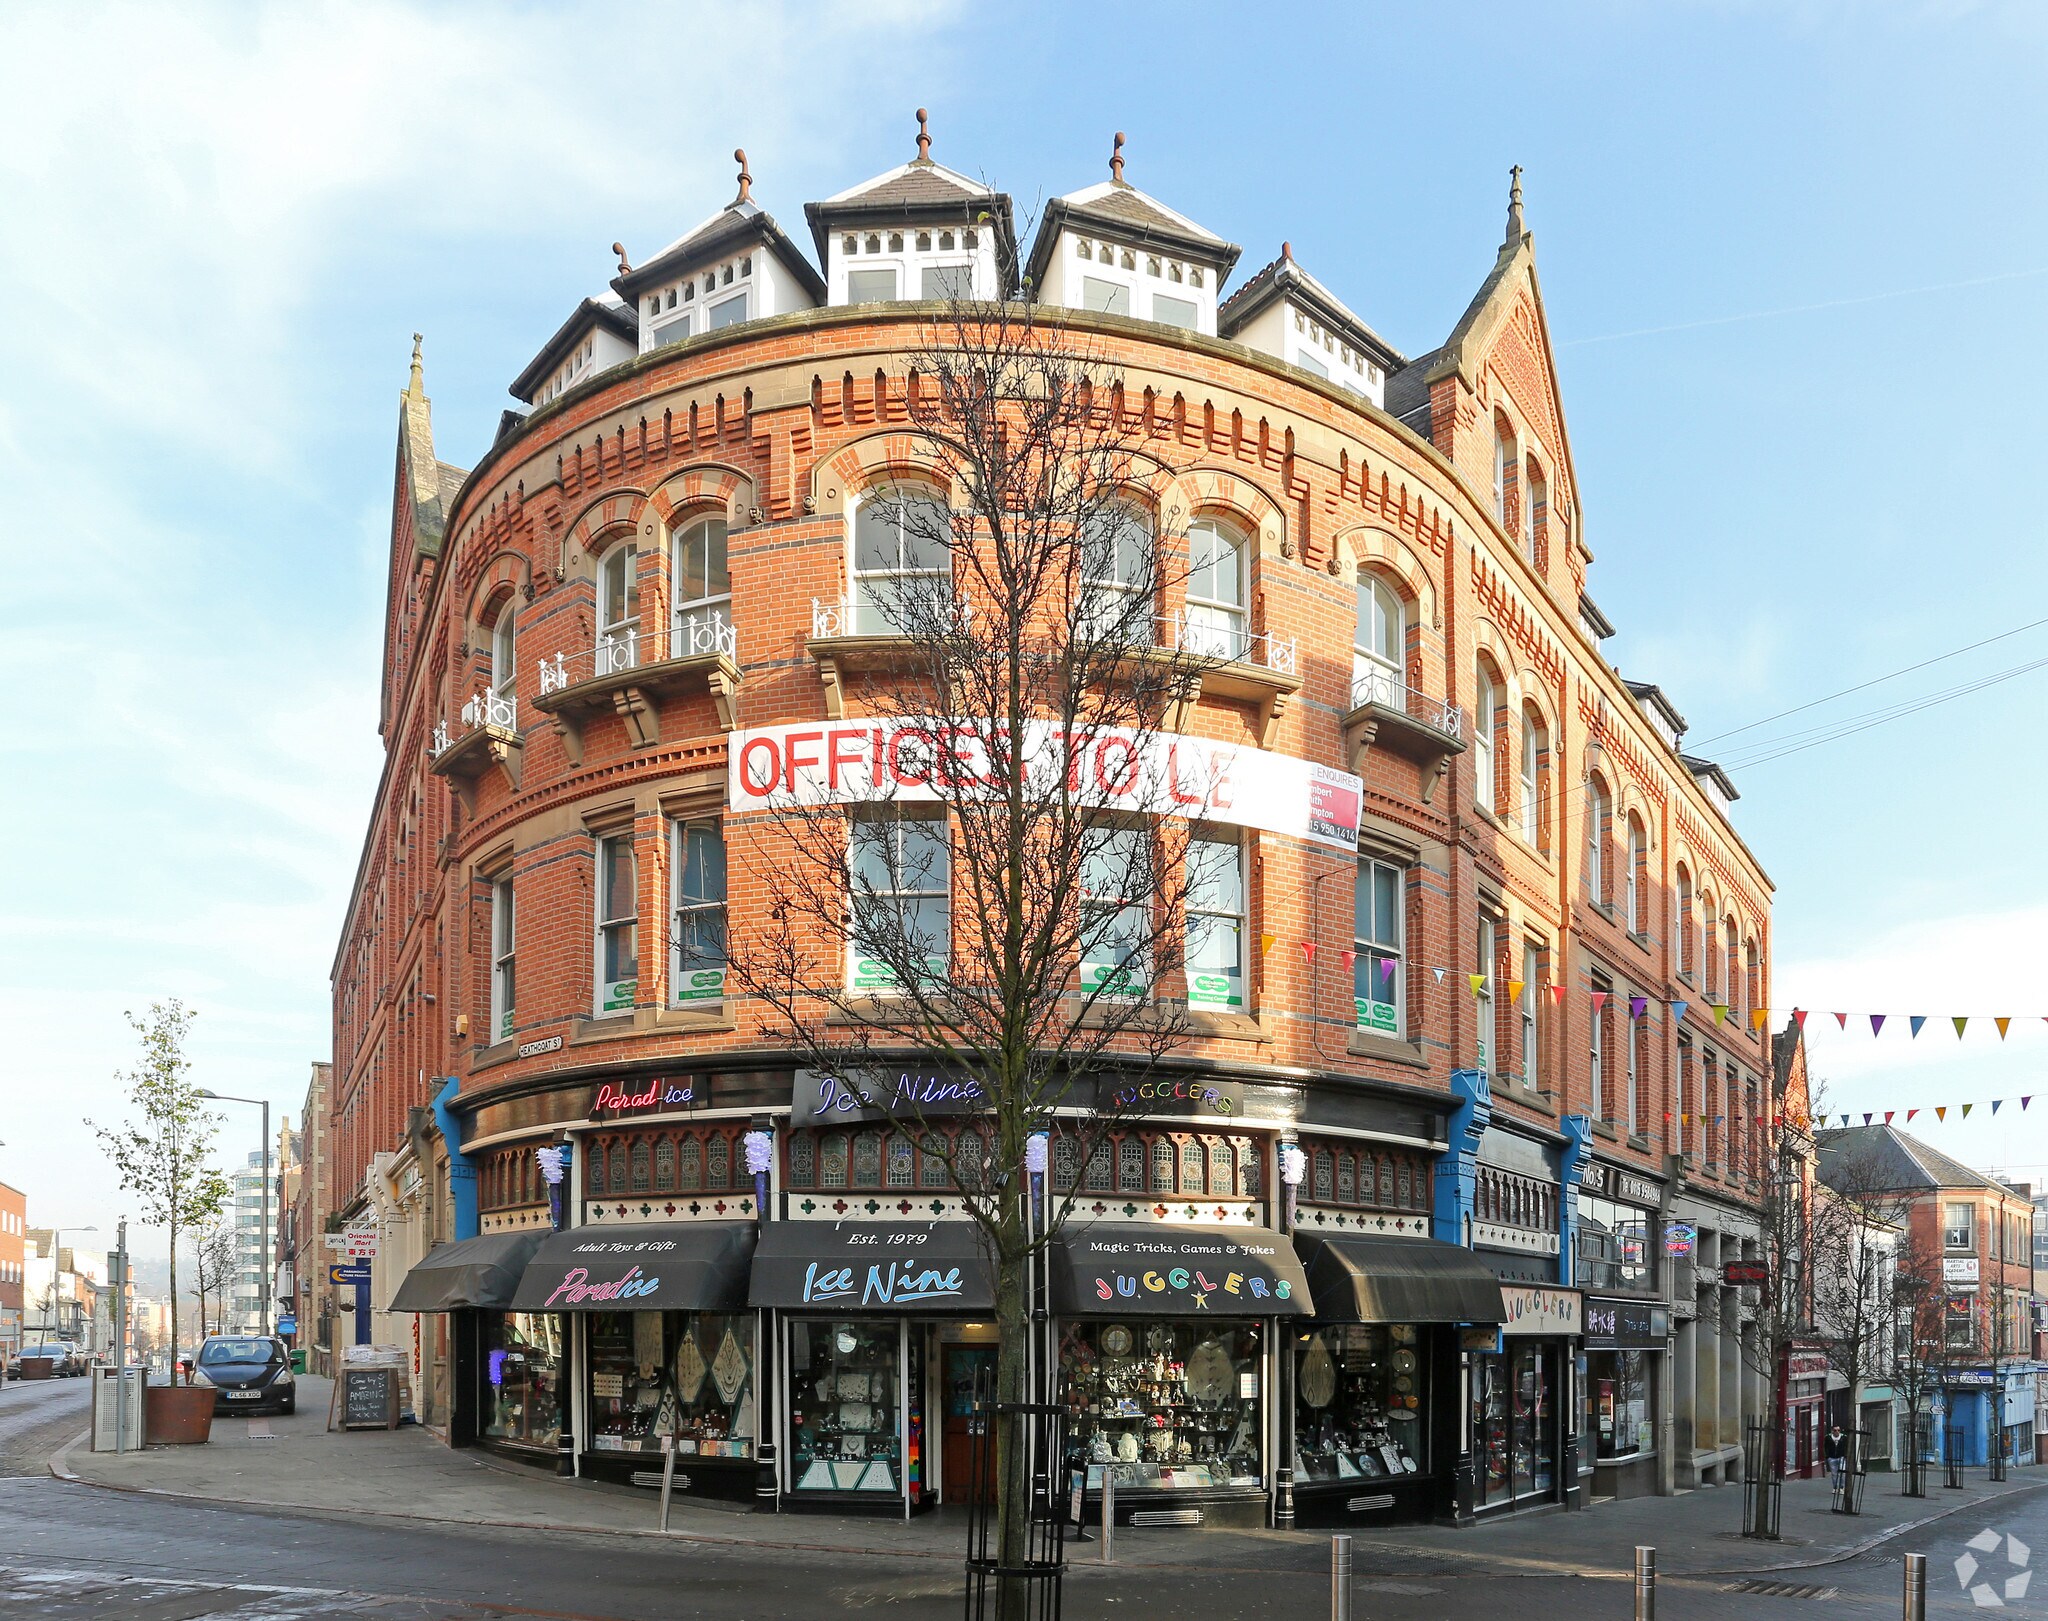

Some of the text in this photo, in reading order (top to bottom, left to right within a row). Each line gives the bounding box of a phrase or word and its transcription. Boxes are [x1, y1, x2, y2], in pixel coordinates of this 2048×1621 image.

[1052, 731, 1139, 796] TO
[1168, 743, 1239, 808] LE
[1316, 767, 1359, 789] ENQUIRES
[1311, 785, 1332, 798] mbert
[1310, 806, 1334, 820] mpton
[1320, 823, 1335, 835] 950
[1336, 827, 1355, 841] 1414
[520, 1040, 551, 1056] HEATHCOAT
[813, 1073, 983, 1116] Ice Nine
[347, 1232, 376, 1240] Oriental
[847, 1233, 928, 1245] Est. 1979
[572, 1239, 677, 1253] Adult Toys & Gifts
[1090, 1241, 1275, 1257] Magic Tricks, Games & Jokes
[1668, 1243, 1689, 1251] OPEN
[544, 1265, 660, 1307] Paradice
[802, 1259, 964, 1306] Ice Nine
[1095, 1267, 1292, 1301] JUGGLERS
[1508, 1289, 1572, 1323] JUGGLERS
[349, 1390, 384, 1401] AMAZING
